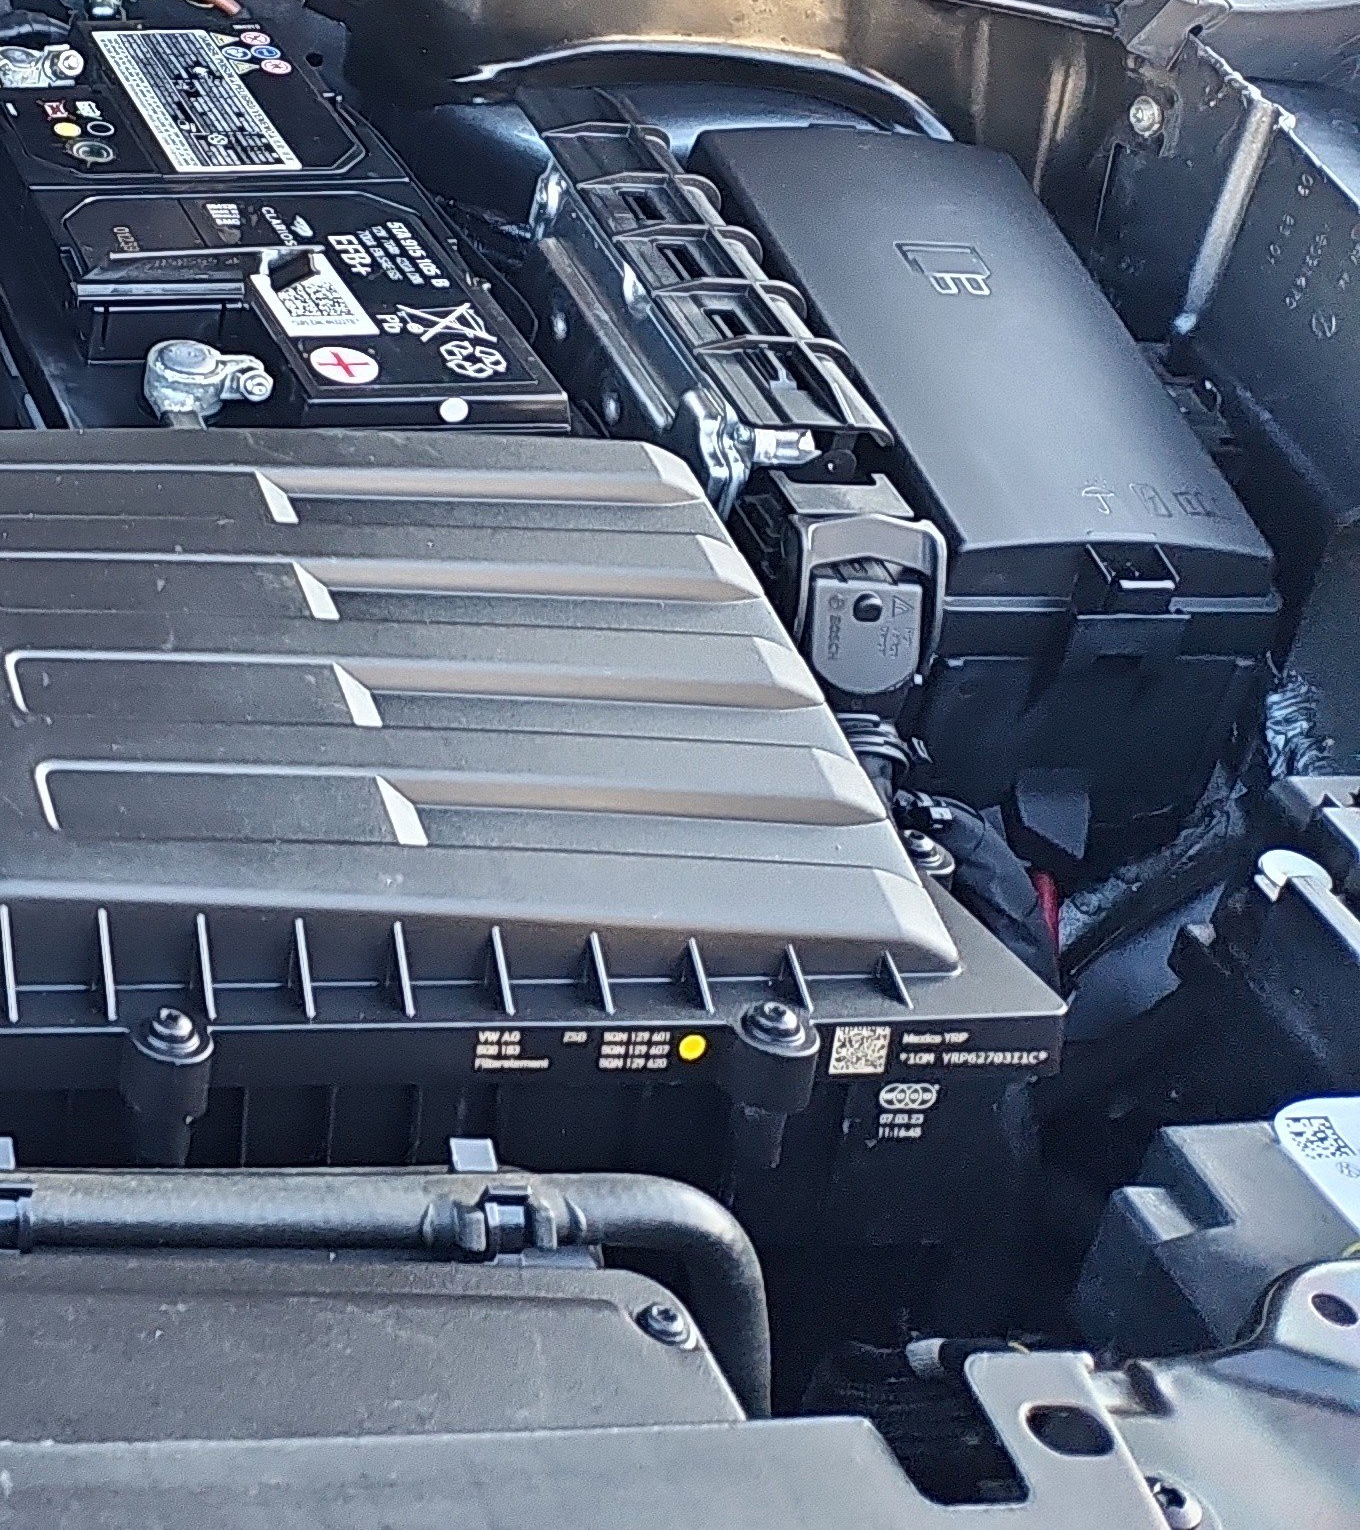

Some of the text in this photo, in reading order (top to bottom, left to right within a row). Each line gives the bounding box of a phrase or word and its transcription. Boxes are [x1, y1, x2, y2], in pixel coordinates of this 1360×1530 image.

[261, 206, 298, 246] CLARIOS
[327, 234, 373, 277] EFB+
[400, 239, 427, 258] 915
[415, 258, 442, 277] 105
[375, 314, 404, 334] Pb
[478, 1030, 501, 1043] VW
